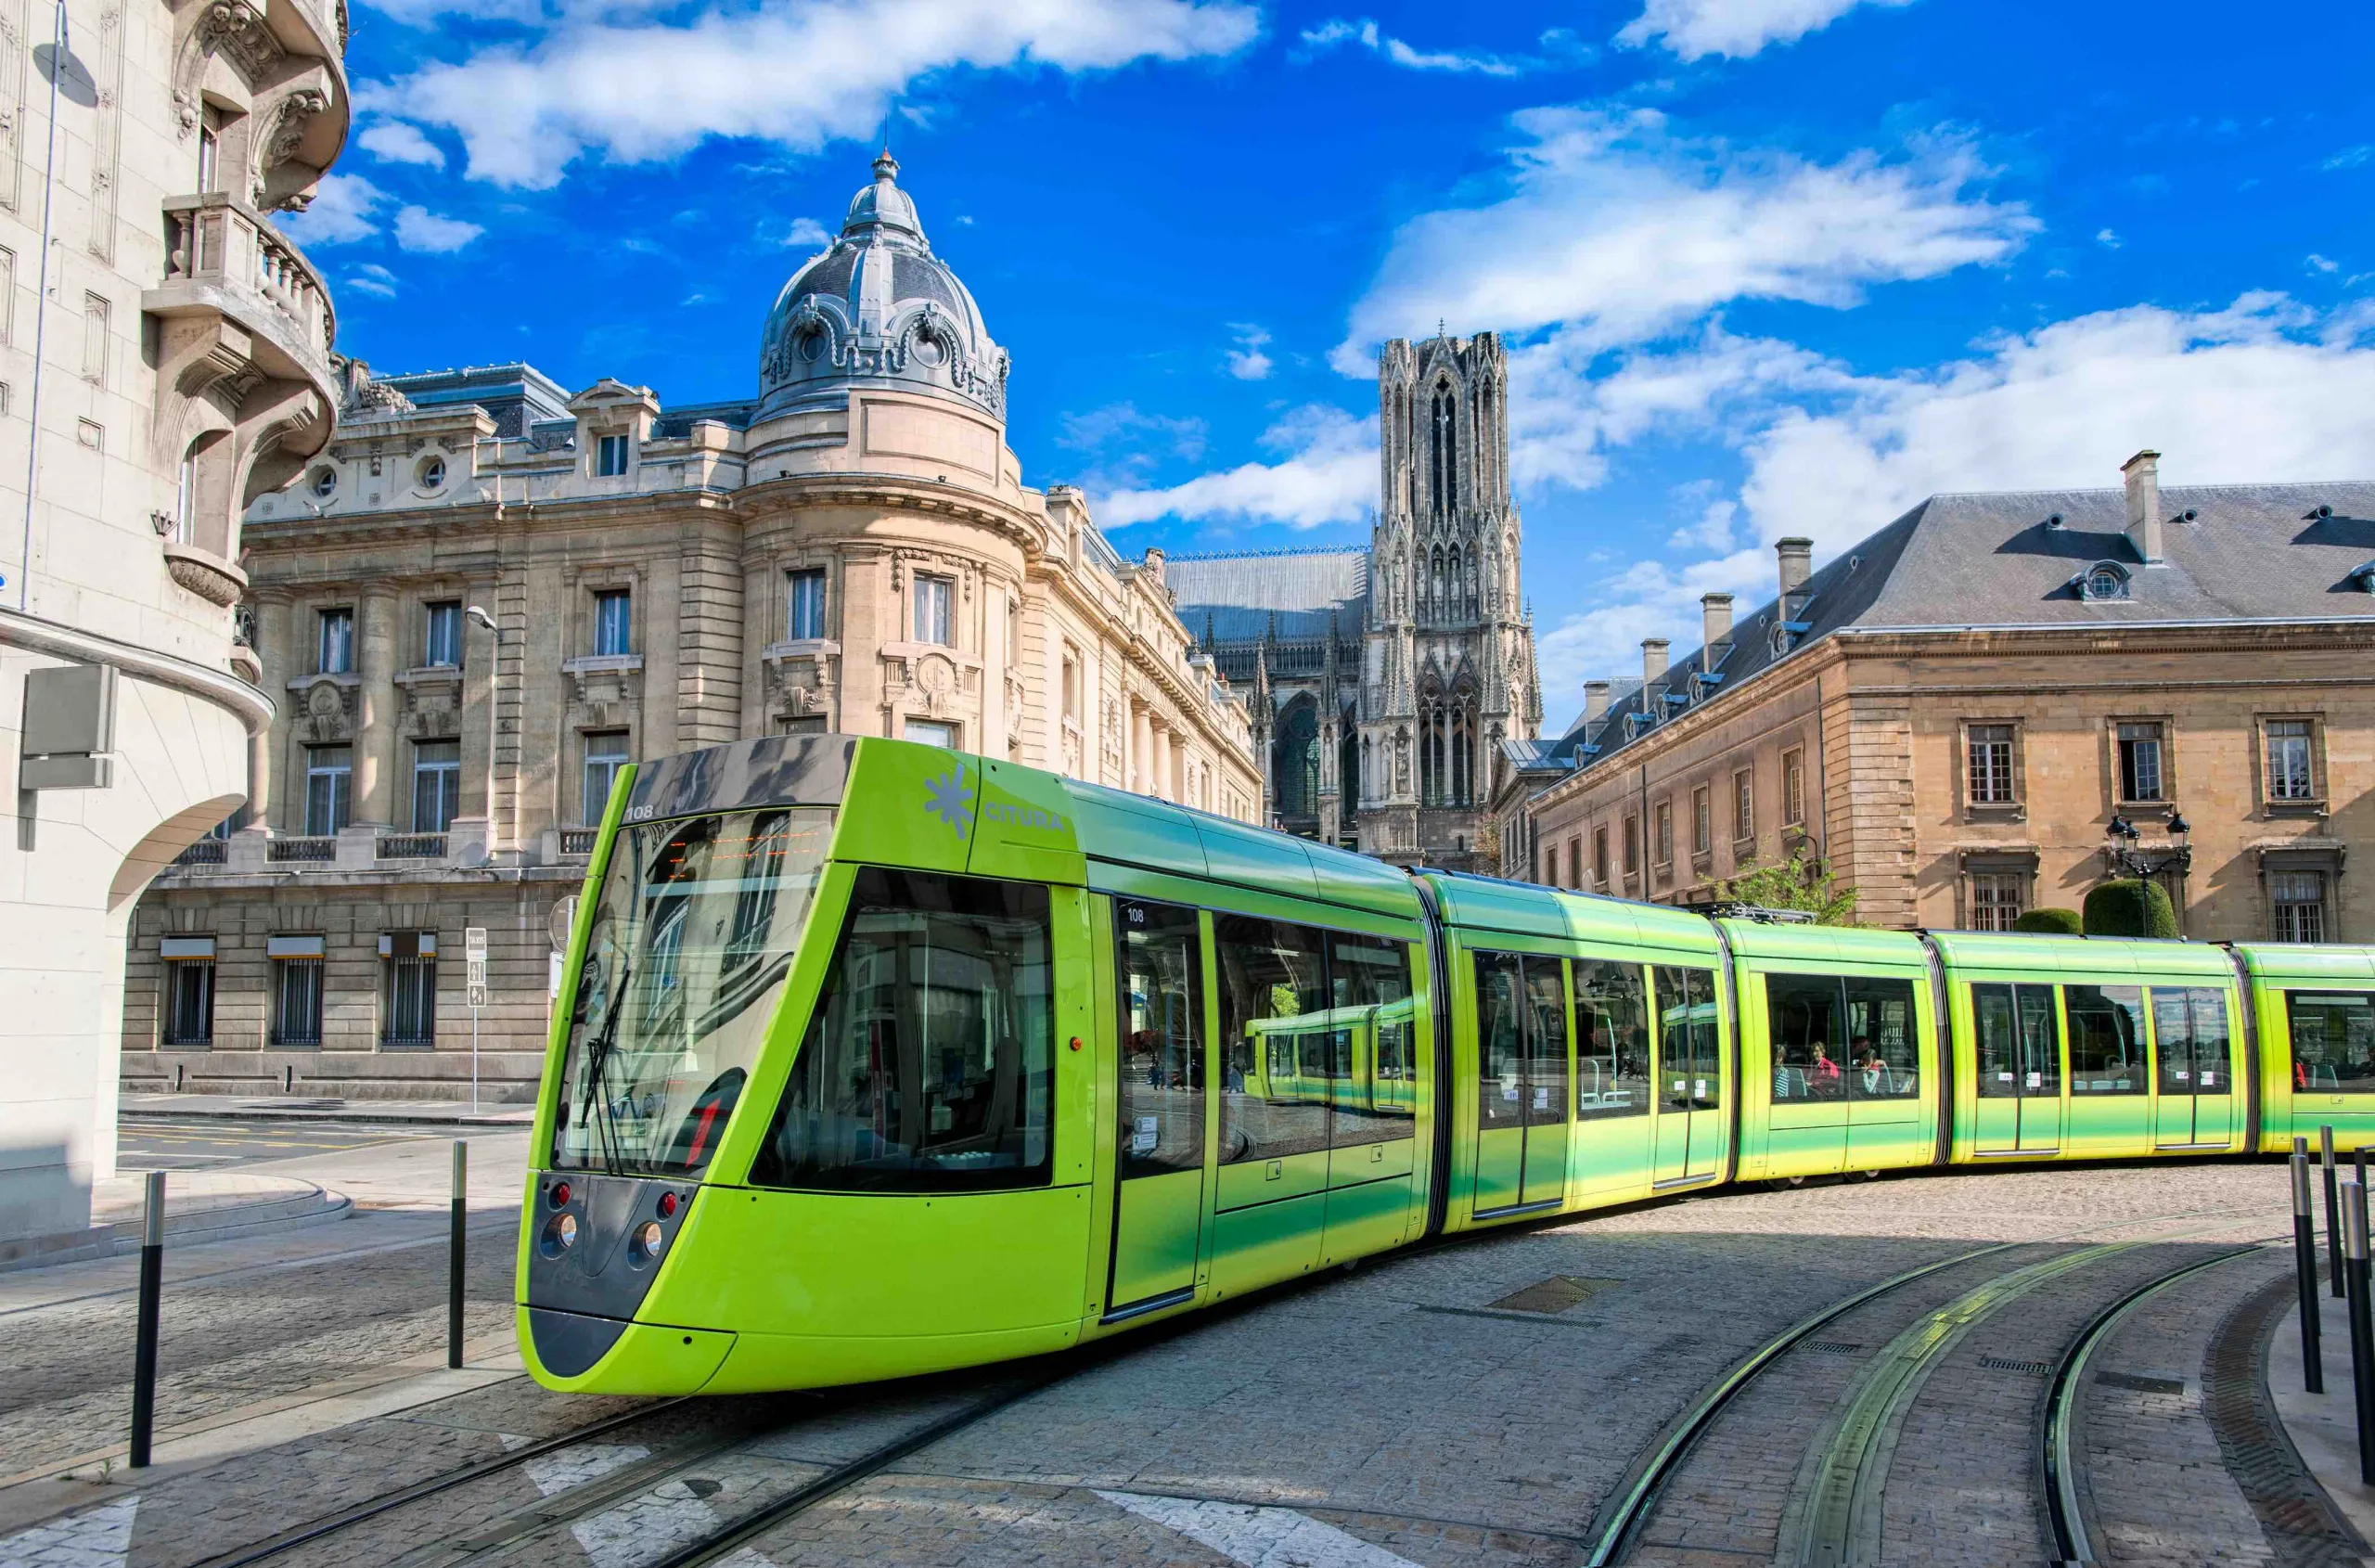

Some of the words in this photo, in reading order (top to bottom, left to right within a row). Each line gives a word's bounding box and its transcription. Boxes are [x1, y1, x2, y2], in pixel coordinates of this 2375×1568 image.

[625, 804, 654, 821] 108
[984, 803, 1065, 832] CITURA
[1128, 907, 1144, 922] 108
[469, 936, 485, 945] TAXIS
